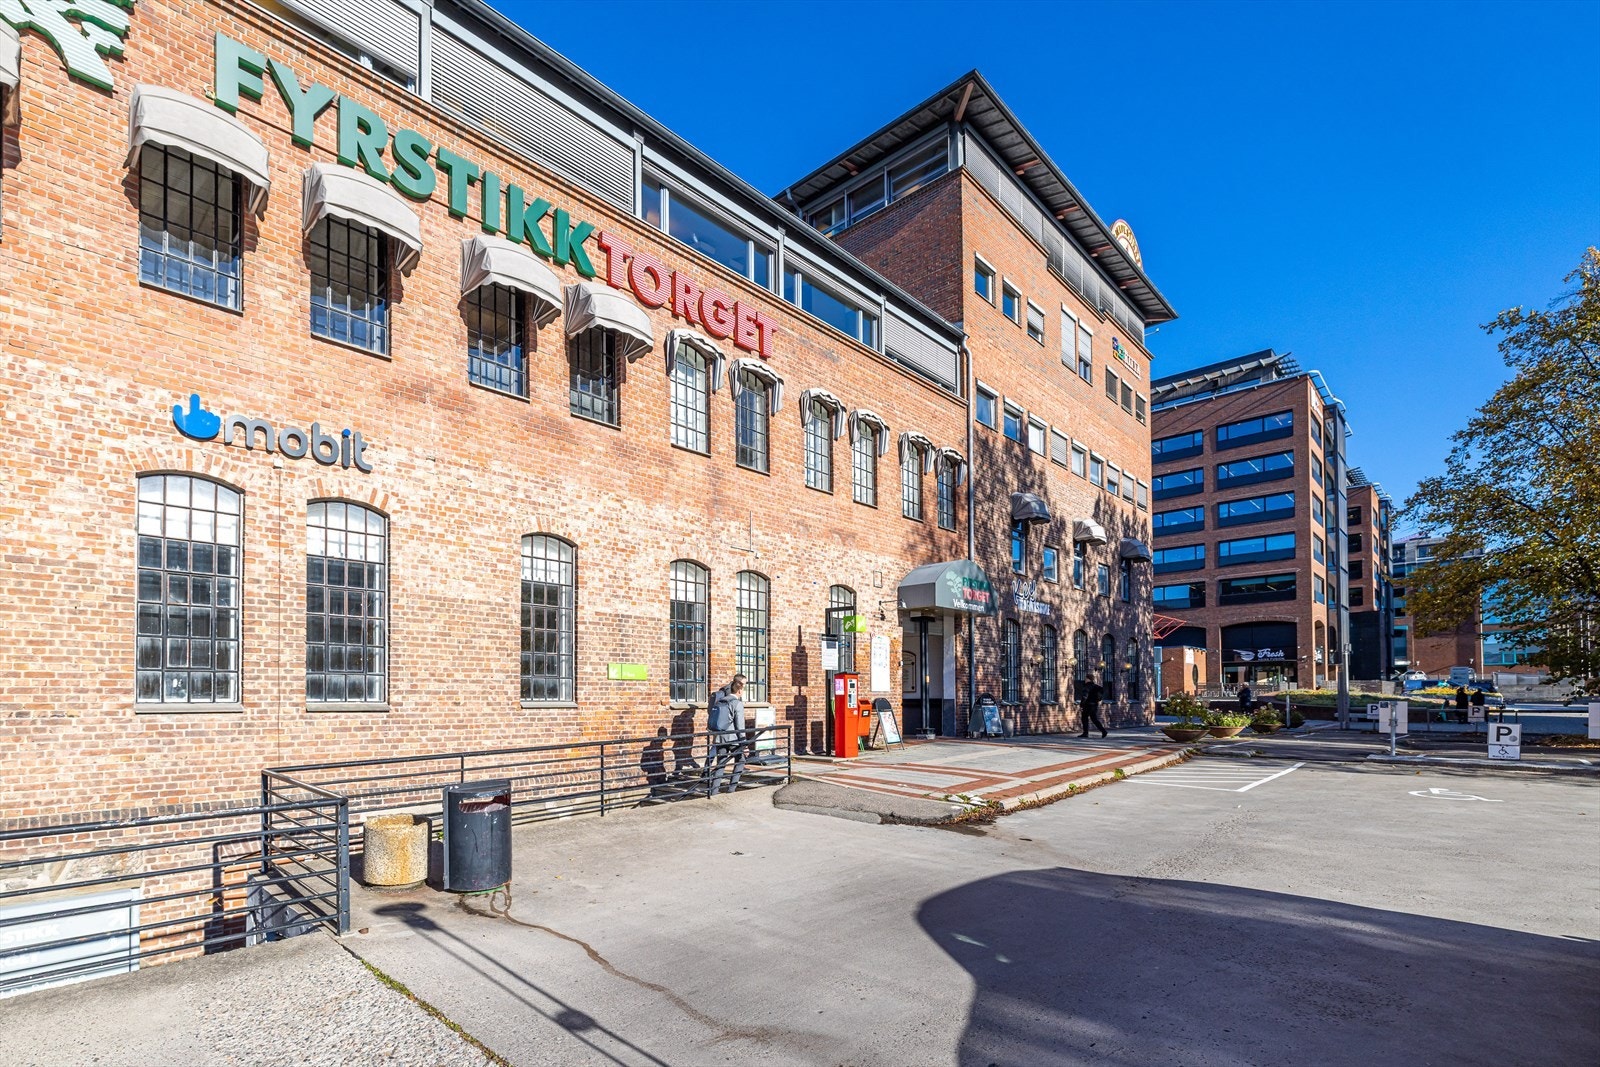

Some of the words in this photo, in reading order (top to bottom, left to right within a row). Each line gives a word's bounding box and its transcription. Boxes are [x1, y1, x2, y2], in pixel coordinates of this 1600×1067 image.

[224, 414, 373, 474] mobit
[953, 598, 985, 611] Velkommen
[1370, 705, 1378, 713] P
[1472, 707, 1480, 716] P
[1495, 726, 1512, 742] P
